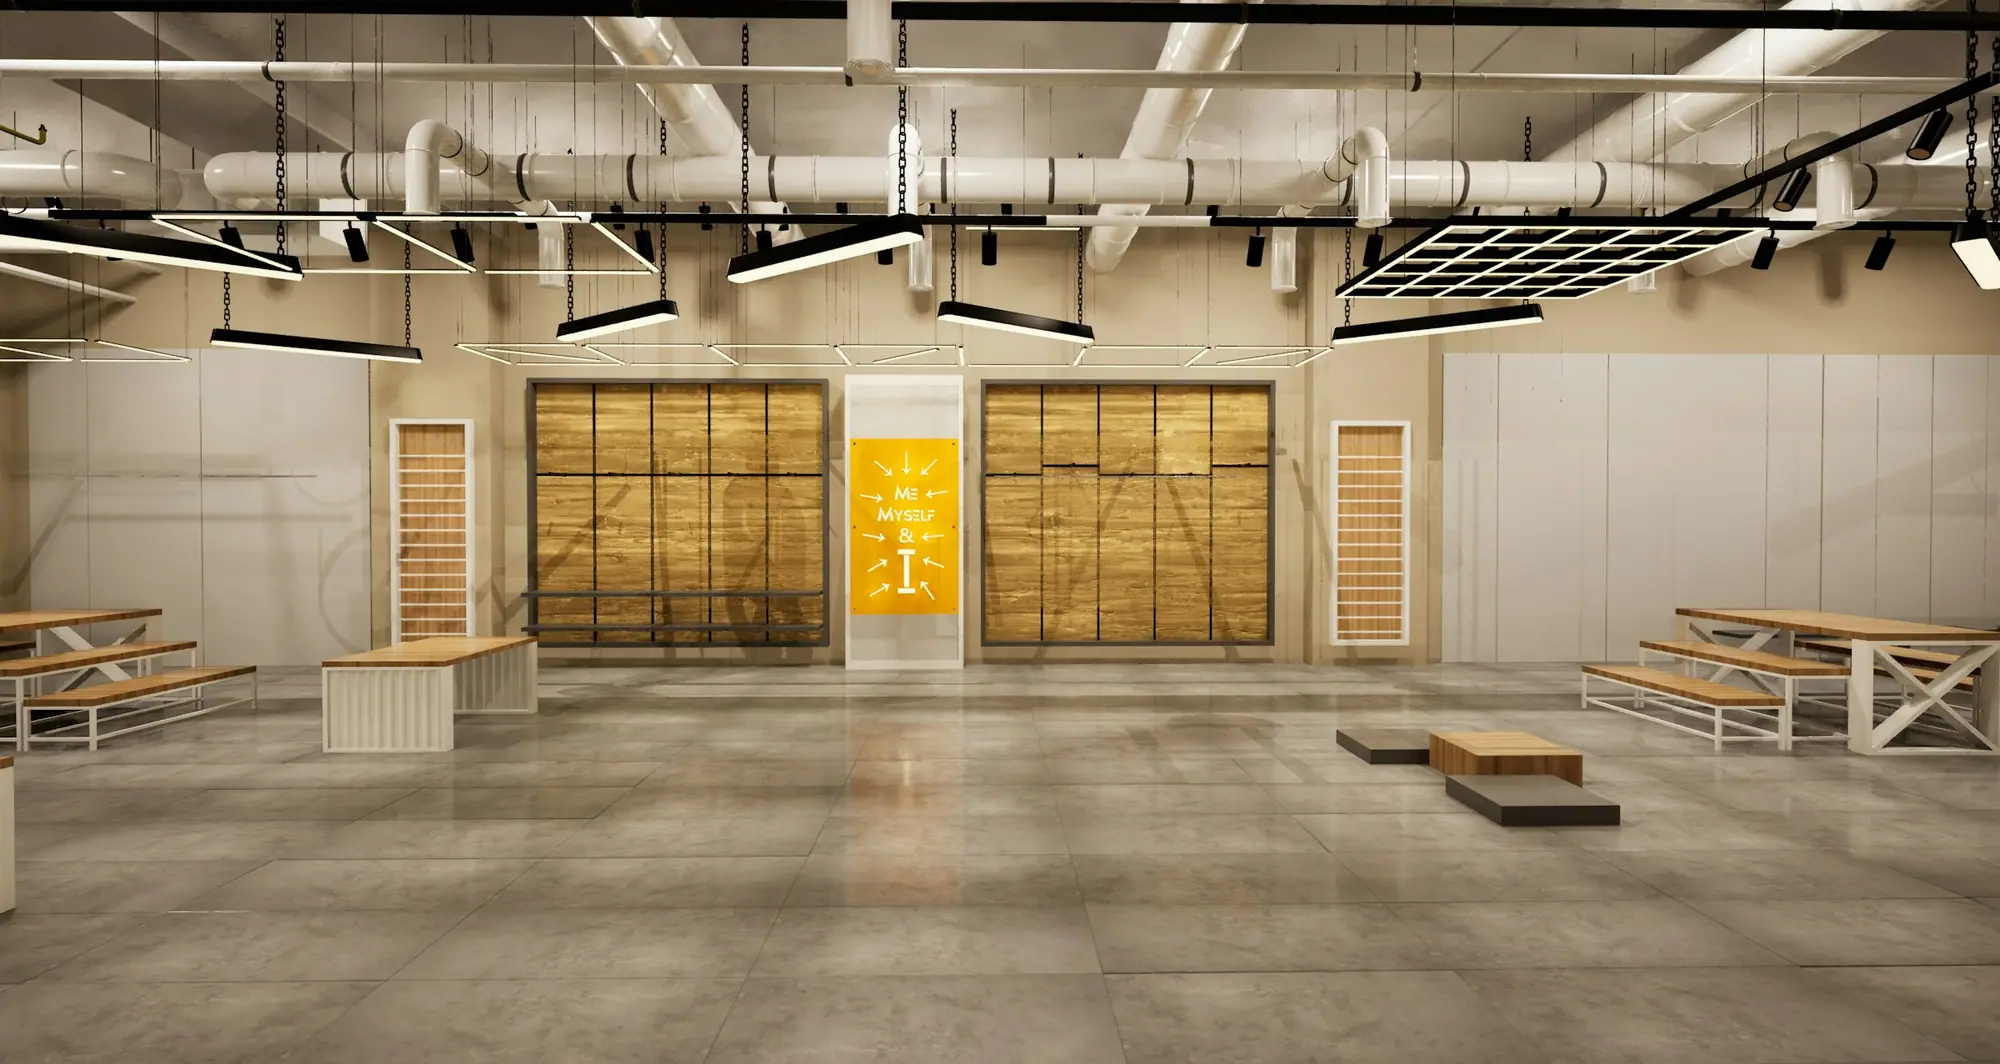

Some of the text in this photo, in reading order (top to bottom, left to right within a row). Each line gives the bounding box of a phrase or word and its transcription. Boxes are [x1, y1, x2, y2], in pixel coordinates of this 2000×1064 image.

[894, 485, 919, 501] ME
[877, 507, 936, 522] MYSELF
[898, 527, 915, 544] &
[897, 549, 916, 594] I
